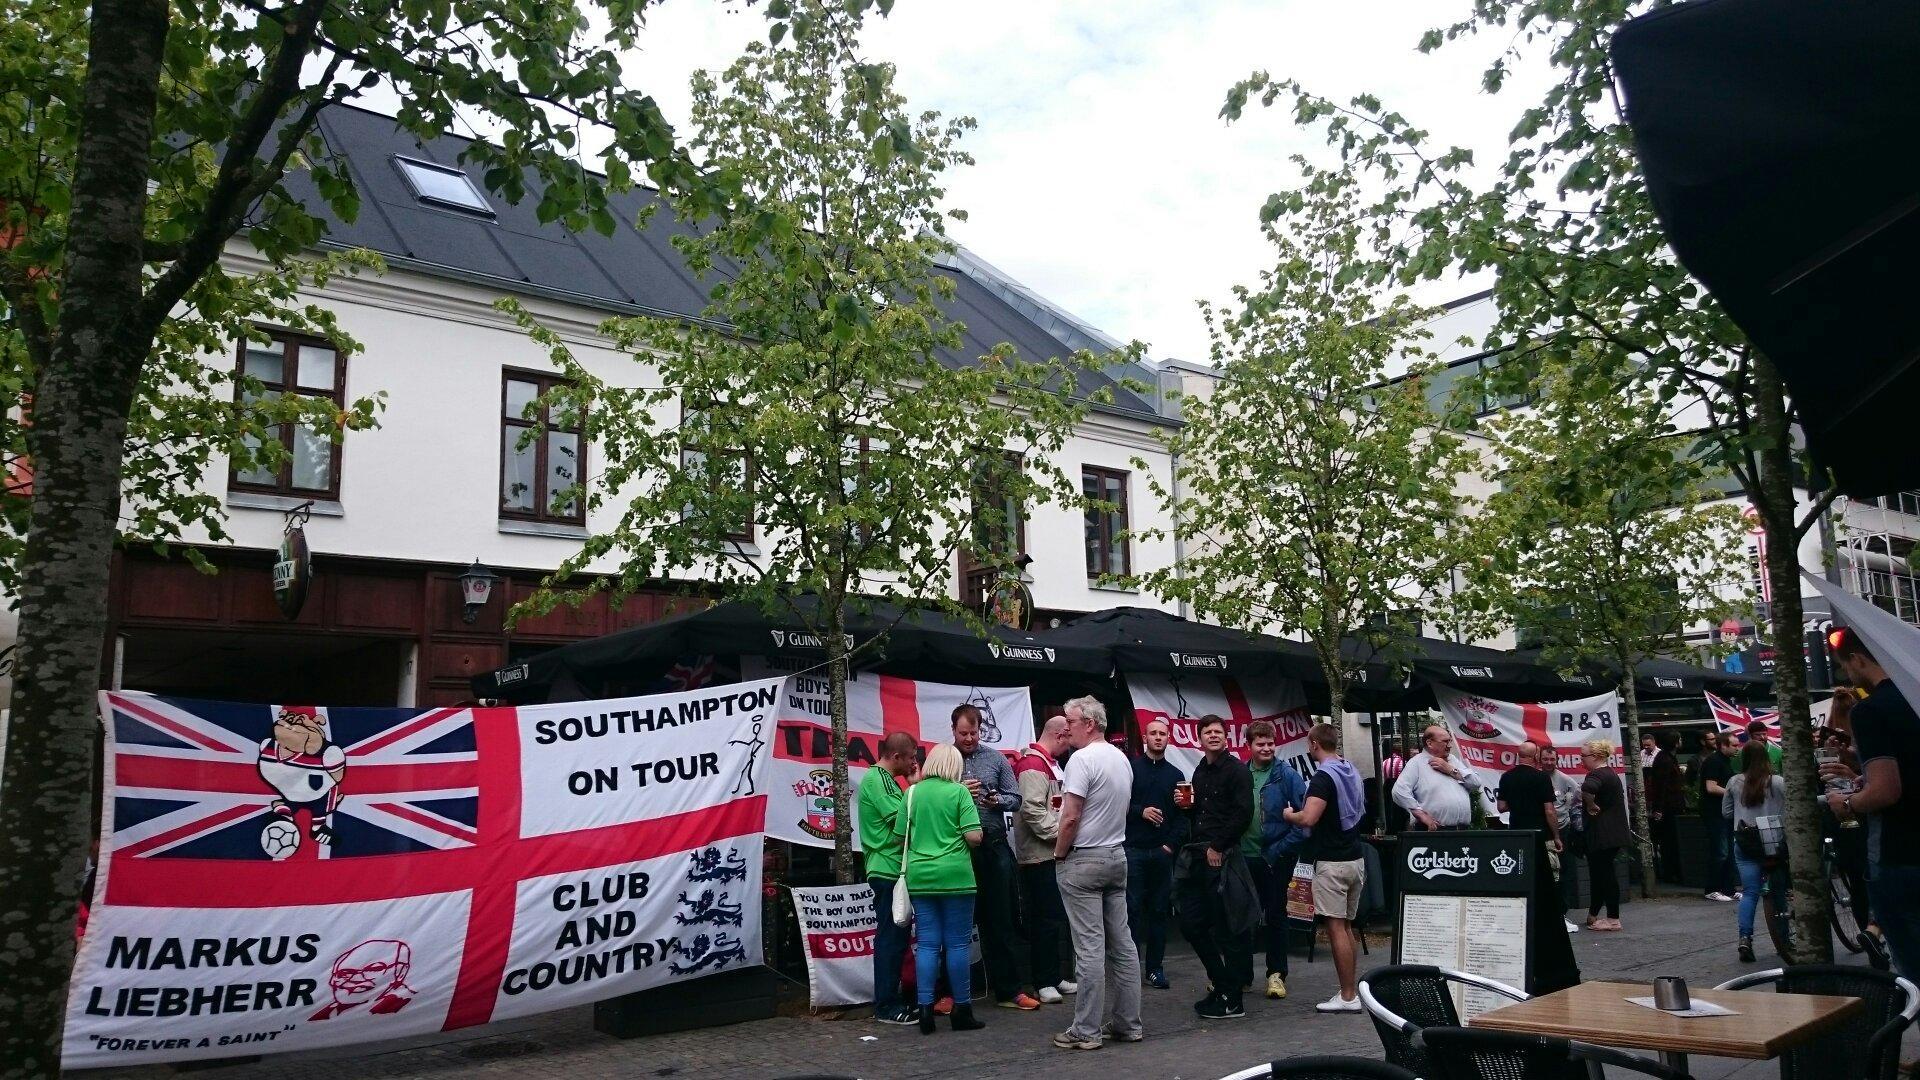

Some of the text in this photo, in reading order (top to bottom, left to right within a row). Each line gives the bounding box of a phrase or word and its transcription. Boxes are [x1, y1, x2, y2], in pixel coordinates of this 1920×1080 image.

[789, 633, 829, 647] GUINN
[1002, 646, 1043, 660] GUINNESS
[1182, 655, 1217, 667] GUINNESS
[502, 668, 523, 683] GUINNESS
[1460, 667, 1486, 677] GUINNESS
[796, 677, 830, 695] BOYS
[535, 685, 778, 745] SOUTHAMPTON
[789, 695, 831, 716] ON TOU
[1559, 711, 1612, 731] R & B
[568, 752, 719, 795] ON TOUR
[1408, 846, 1479, 878] Carlsberg
[552, 872, 650, 912] CLUB
[799, 889, 874, 903] YOU CAN TAKE
[803, 906, 823, 916] THE
[826, 907, 843, 916] BOY
[846, 905, 865, 914] OUT
[555, 910, 637, 950] AND
[105, 933, 321, 970] MARKUS
[502, 936, 679, 996] COUNTRY
[85, 978, 318, 1017] LIEBHERR
[196, 1037, 210, 1048] A
